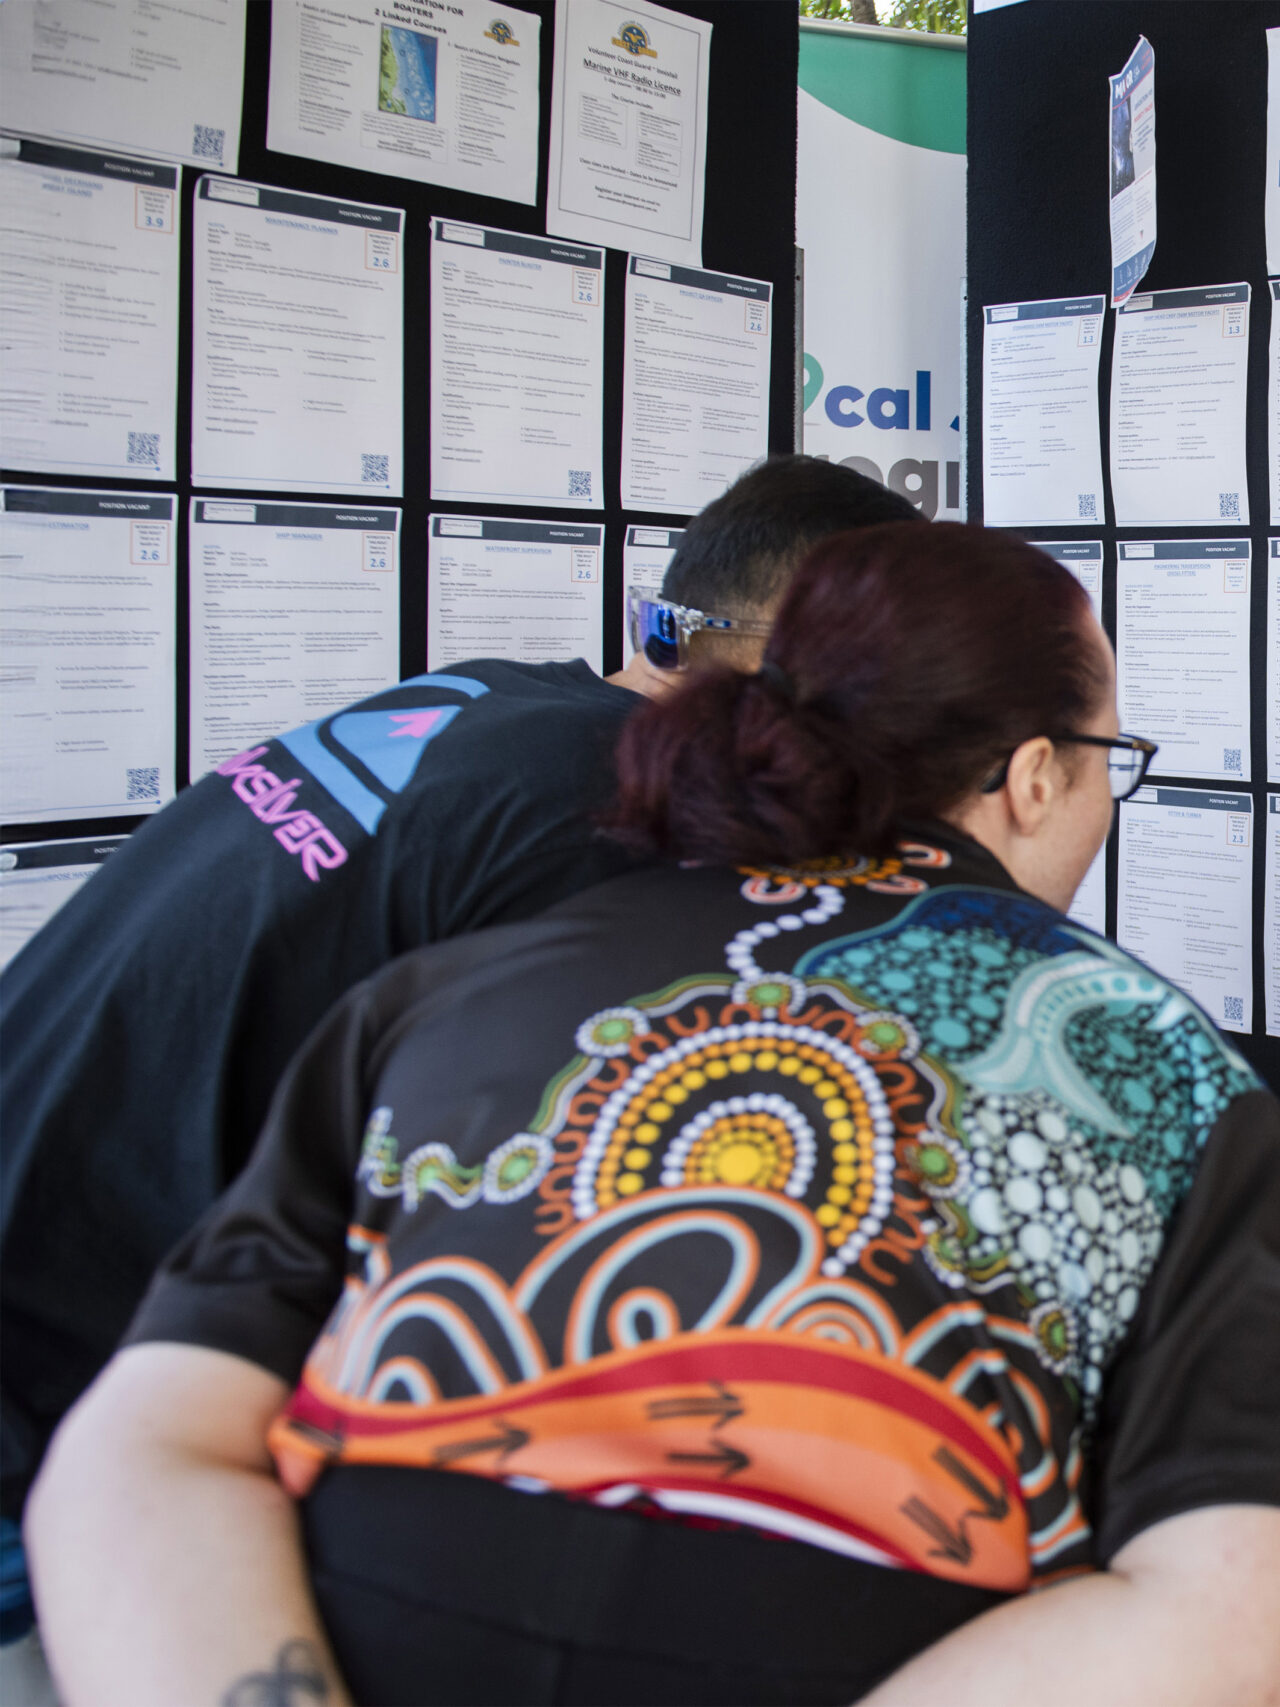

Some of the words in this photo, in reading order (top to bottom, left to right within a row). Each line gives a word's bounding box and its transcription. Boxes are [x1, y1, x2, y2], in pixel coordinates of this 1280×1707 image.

[393, 2, 434, 18] BOATERS
[447, 5, 464, 16] FOR
[375, 8, 380, 16] 2
[382, 11, 412, 25] Linked
[414, 19, 447, 34] Courses
[583, 58, 612, 73] Marine
[613, 67, 629, 78] VHF
[631, 73, 653, 86] Radio
[654, 79, 681, 94] Licence
[373, 257, 390, 268] 2.6
[578, 291, 592, 302] 2.6
[750, 322, 762, 331] 2.6
[1229, 325, 1241, 335] 1.3
[140, 549, 160, 561] 2.6
[370, 558, 386, 568] 2.6
[577, 570, 591, 579] 2.6
[1232, 834, 1244, 844] 2.3
